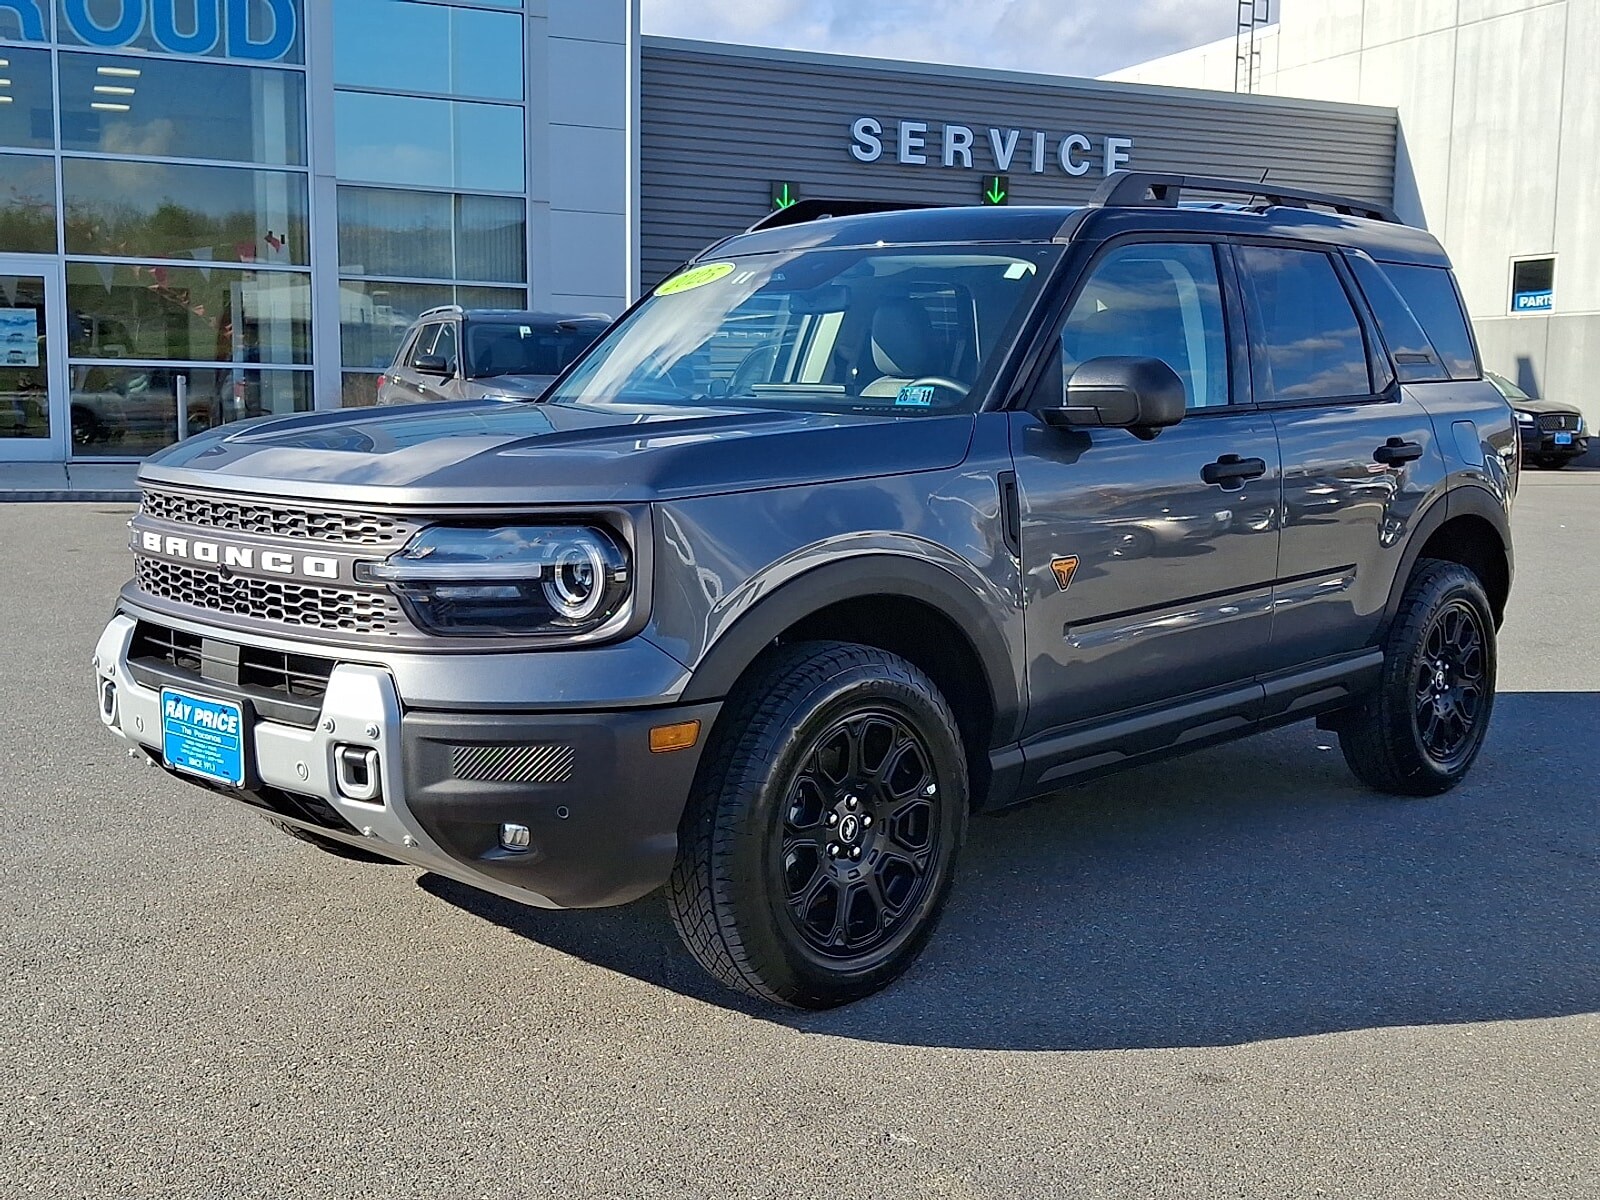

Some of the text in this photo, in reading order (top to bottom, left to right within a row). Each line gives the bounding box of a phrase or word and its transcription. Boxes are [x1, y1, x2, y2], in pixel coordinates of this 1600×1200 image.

[850, 117, 1132, 176] SERVICE
[921, 390, 931, 402] 11
[143, 531, 339, 579] BRONCO
[165, 700, 238, 733] RAY PRICE
